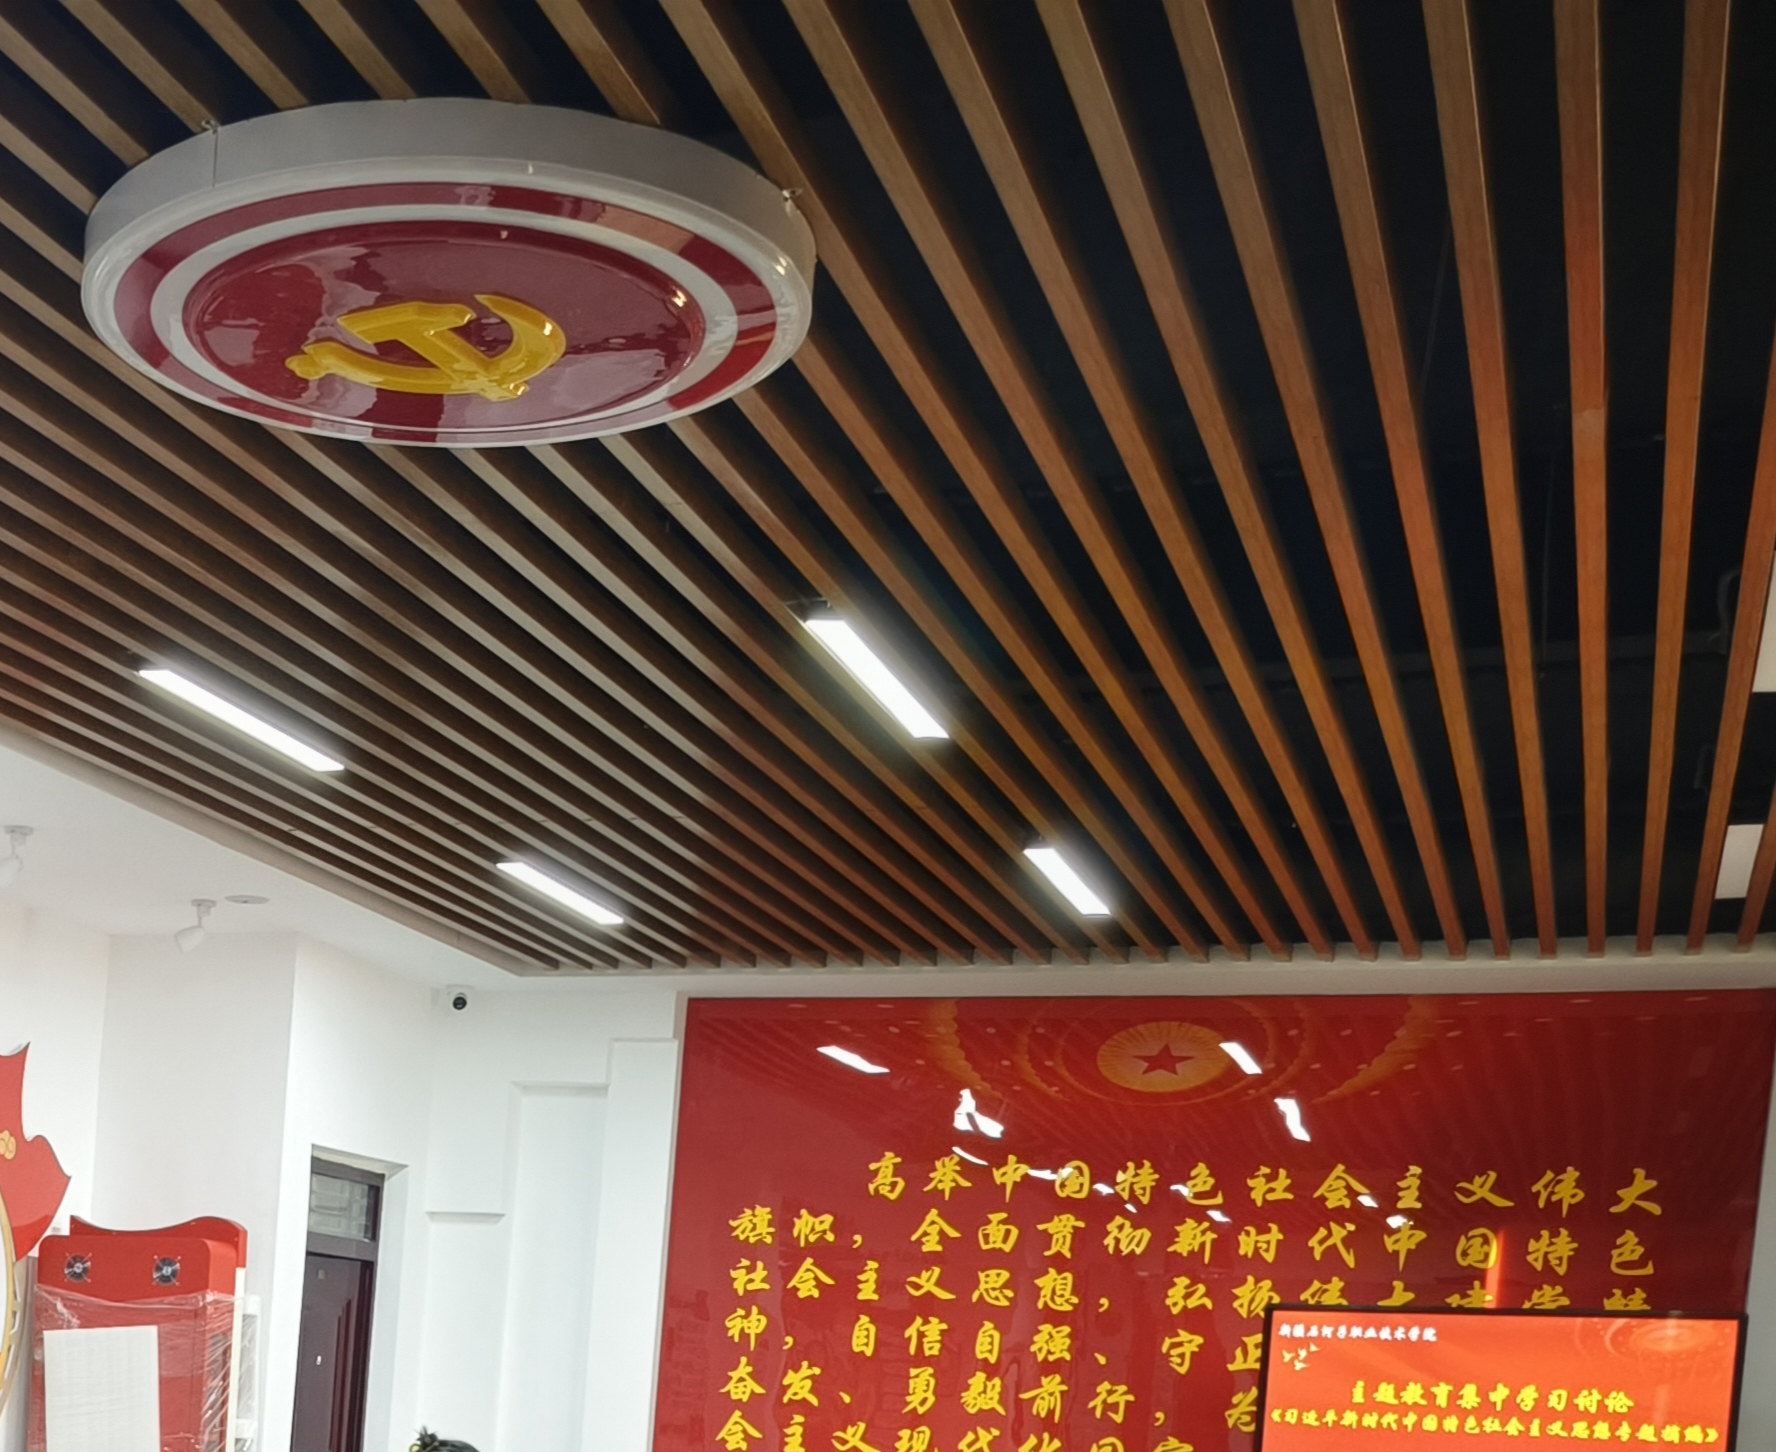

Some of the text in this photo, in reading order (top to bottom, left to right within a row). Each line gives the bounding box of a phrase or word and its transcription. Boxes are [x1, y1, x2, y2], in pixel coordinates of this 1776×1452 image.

[868, 1151, 1663, 1218] 高举中国特色社会主义伟大
[1351, 1380, 1635, 1414] 主题教育集中学习讨论
